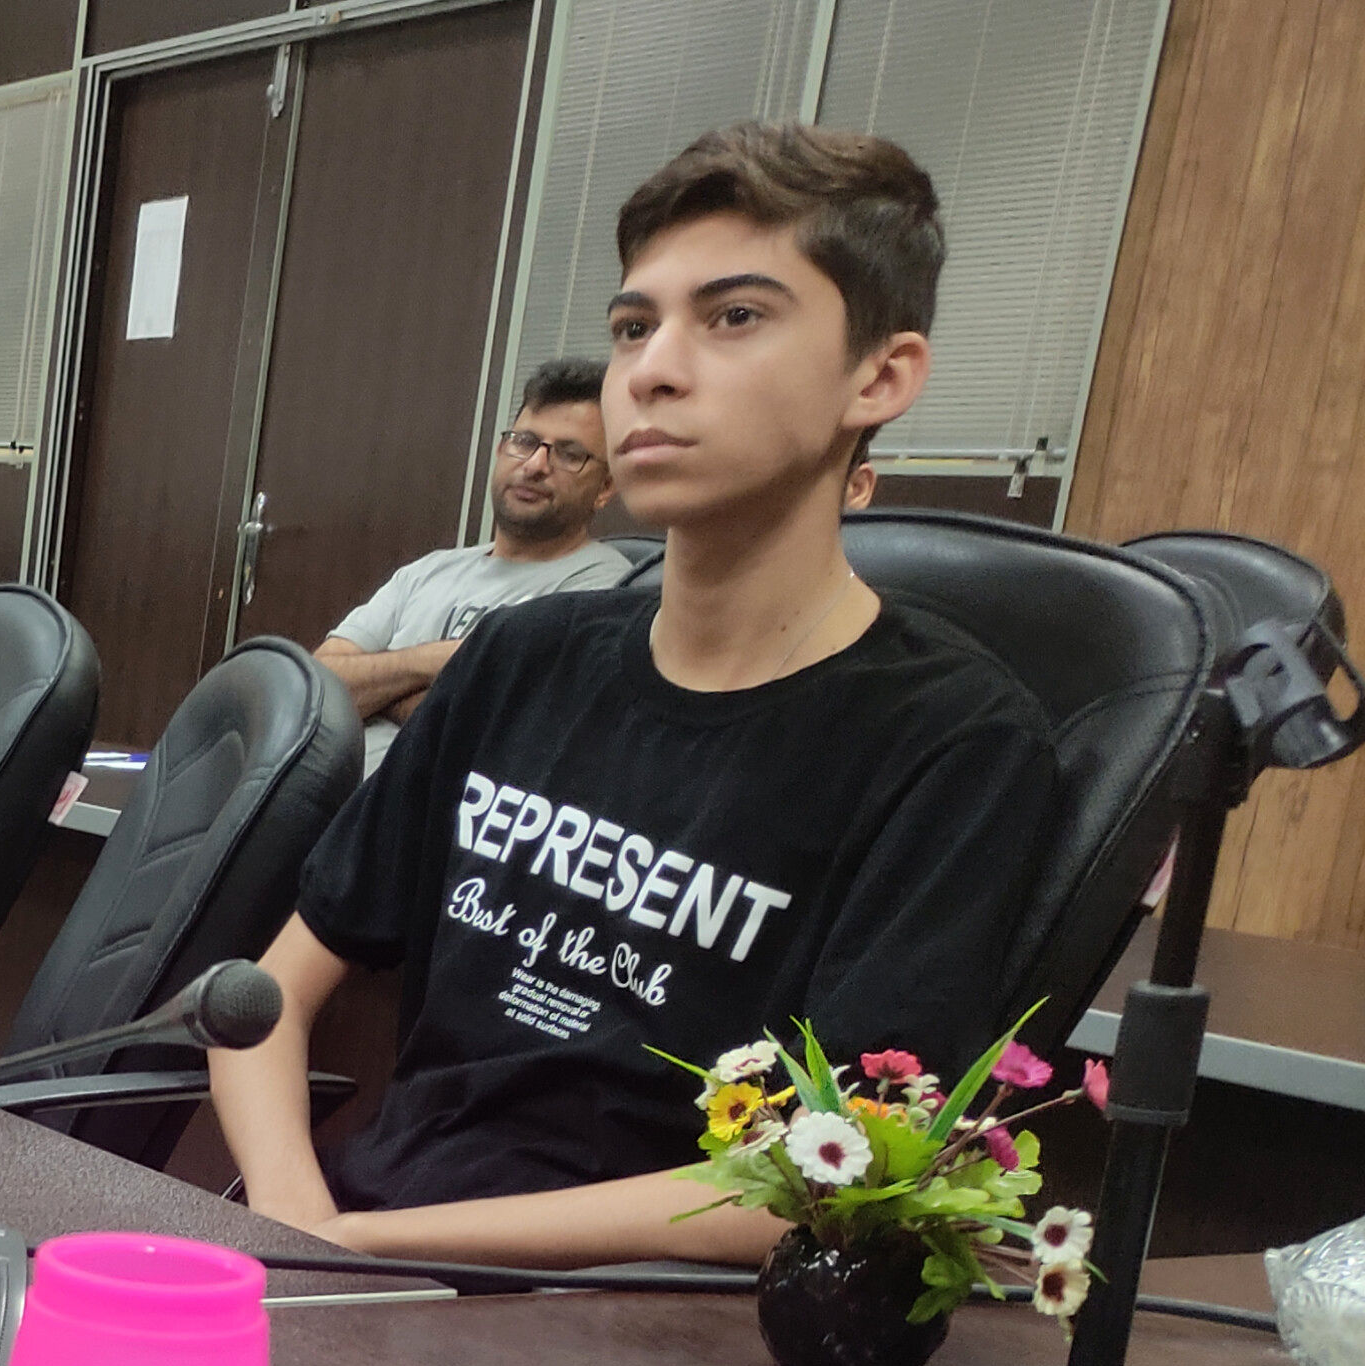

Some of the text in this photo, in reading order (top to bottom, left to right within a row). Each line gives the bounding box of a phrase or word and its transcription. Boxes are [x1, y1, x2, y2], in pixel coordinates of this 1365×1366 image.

[447, 877, 673, 1006] Best of the Club
[457, 770, 793, 963] REPRESENT
